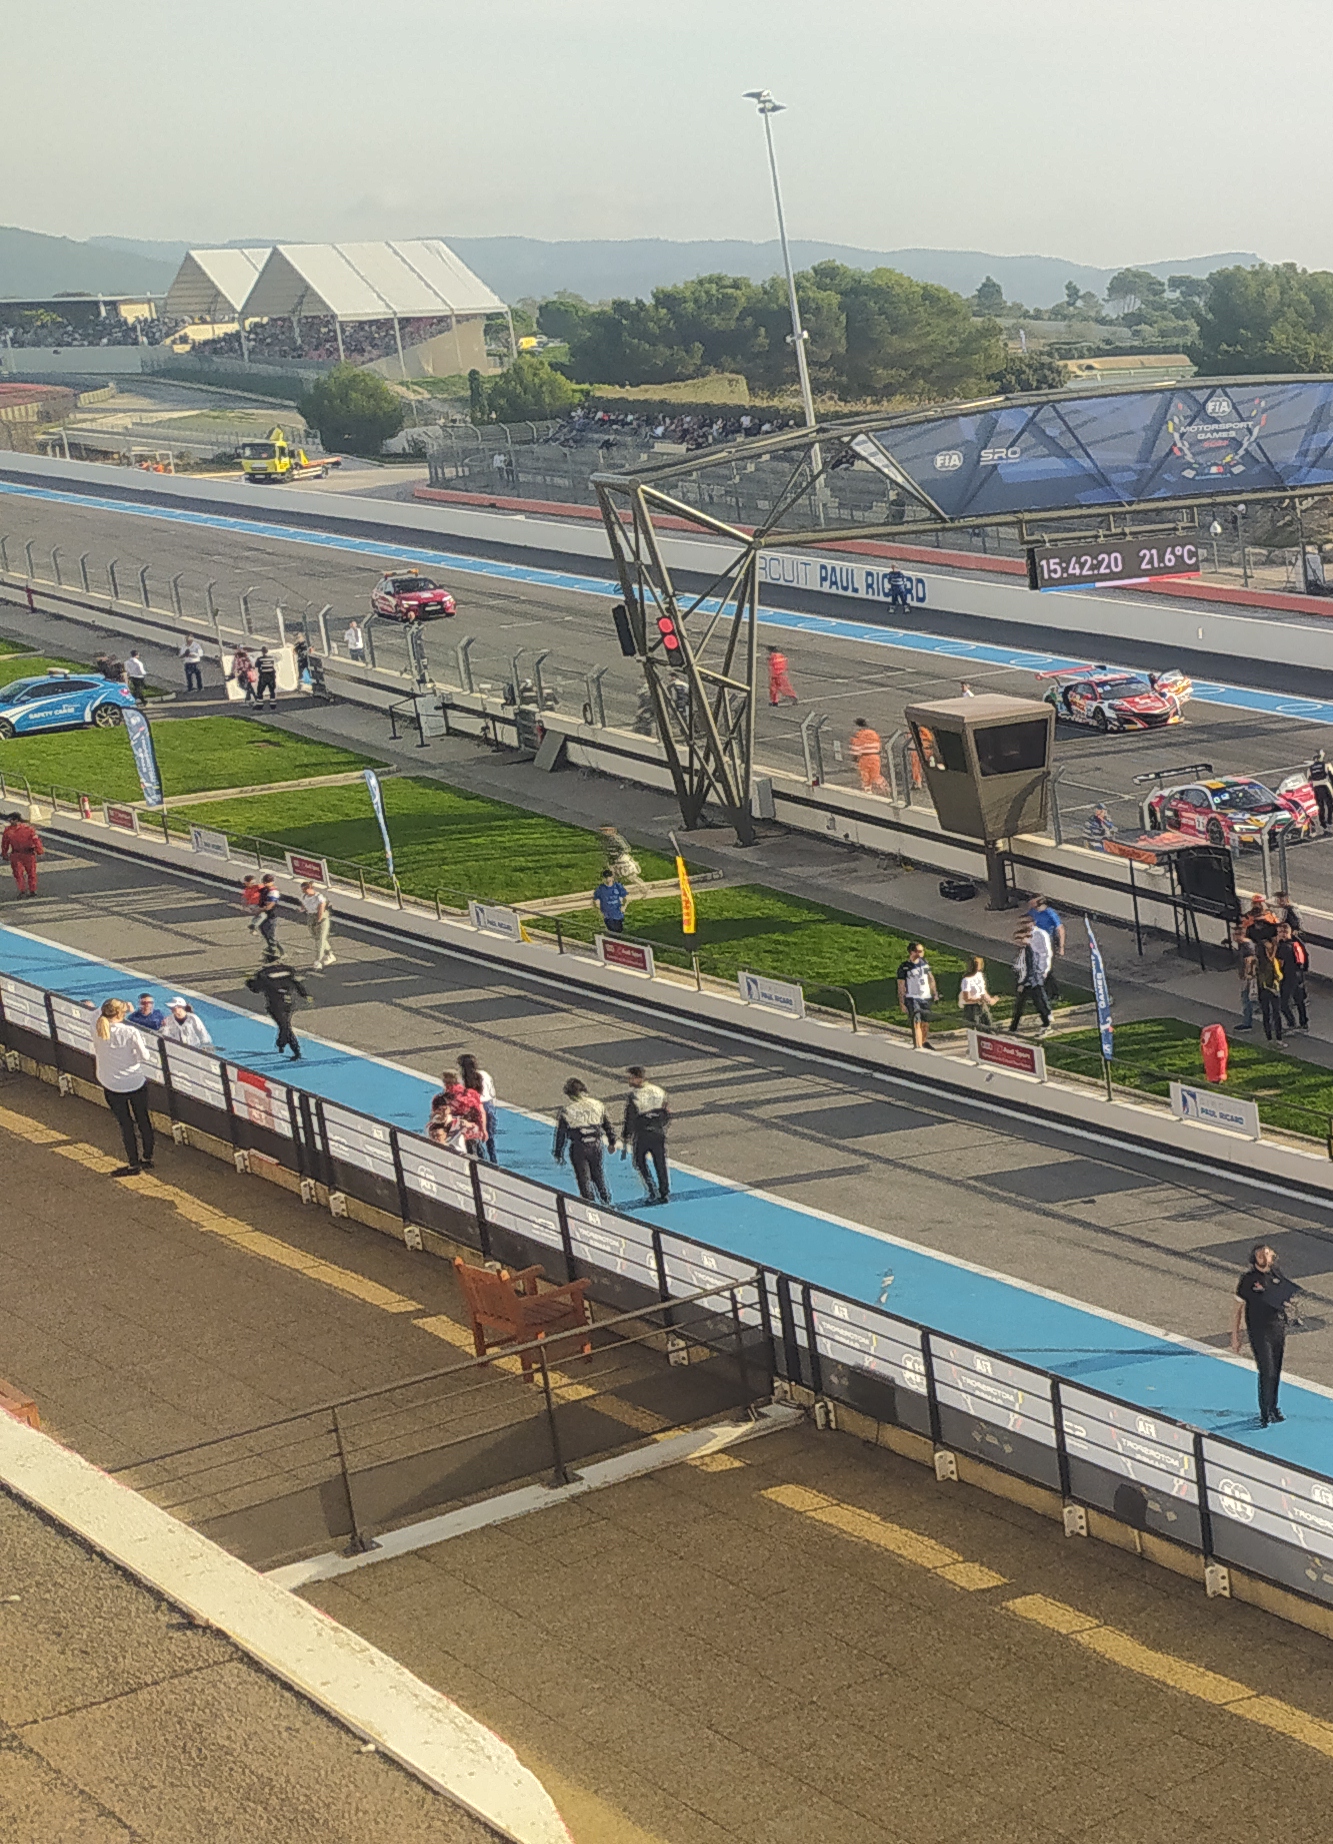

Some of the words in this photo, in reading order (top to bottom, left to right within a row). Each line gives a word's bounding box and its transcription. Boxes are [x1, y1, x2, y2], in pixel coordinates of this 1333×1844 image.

[1206, 400, 1231, 414] FIA
[1180, 421, 1253, 433] MOTORSPORT
[1197, 430, 1236, 440] GAMES
[935, 453, 962, 468] FIA
[980, 447, 1021, 462] SRO
[1040, 552, 1122, 579] 15:42:20
[759, 556, 811, 587] RCUIT
[819, 563, 859, 593] PAUL
[865, 570, 926, 602] RICRD
